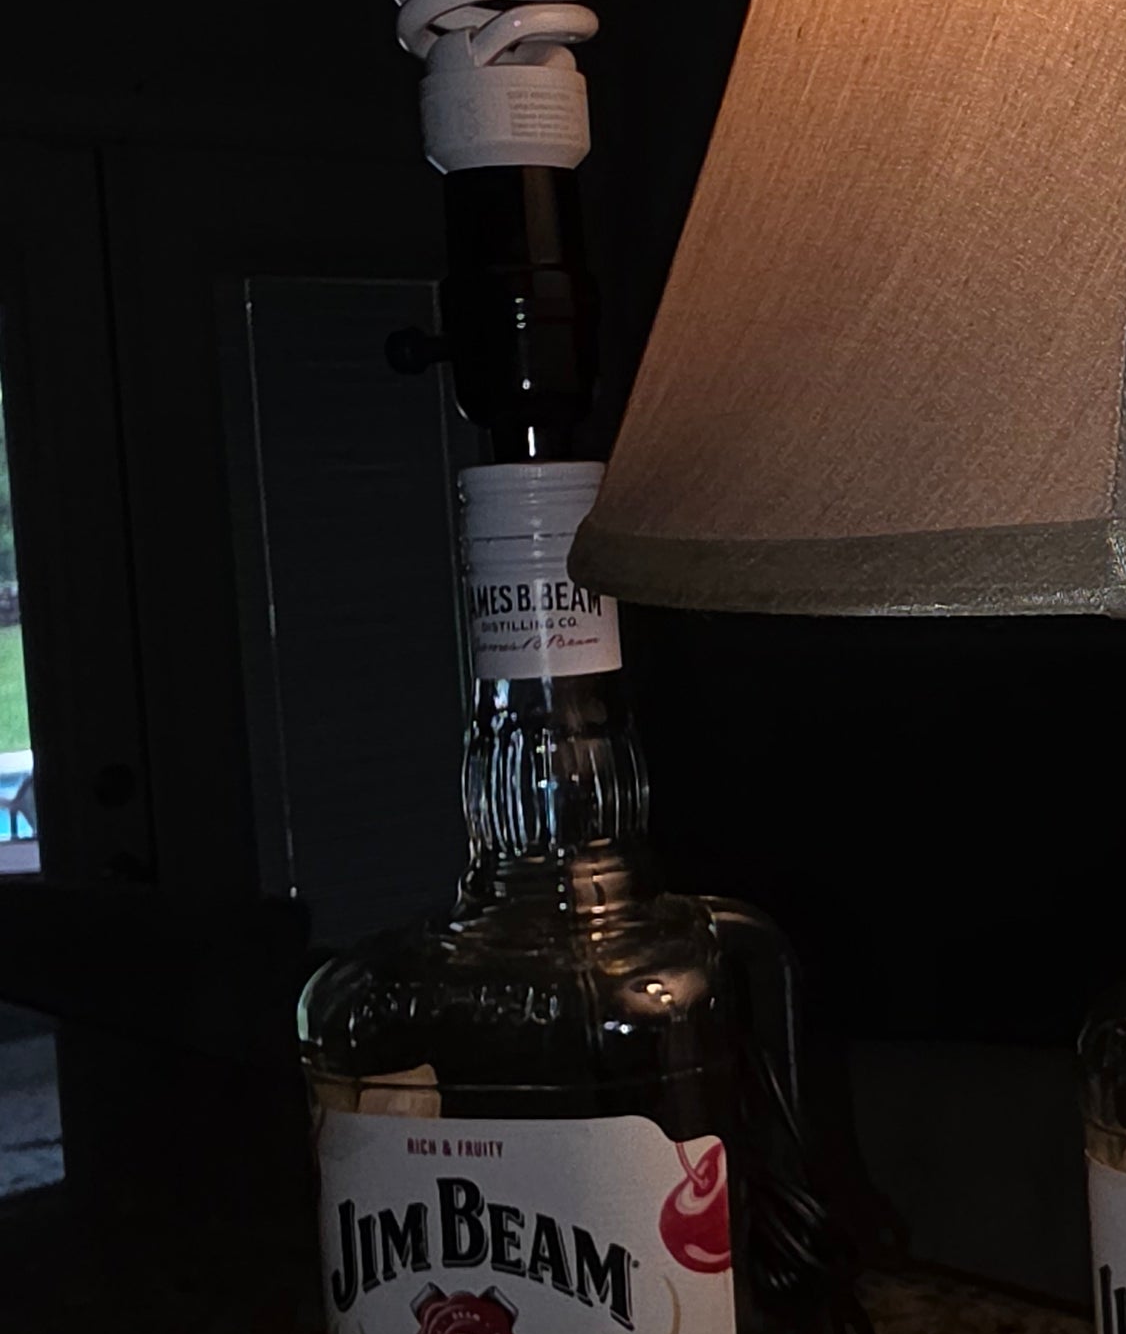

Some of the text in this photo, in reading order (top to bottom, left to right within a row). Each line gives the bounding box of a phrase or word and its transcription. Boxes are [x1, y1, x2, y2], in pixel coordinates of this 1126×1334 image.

[470, 584, 512, 619] AMES
[540, 581, 602, 617] BEAM
[406, 1137, 504, 1158] RICH & FRUITY
[331, 1176, 635, 1331] JIM BEAM
